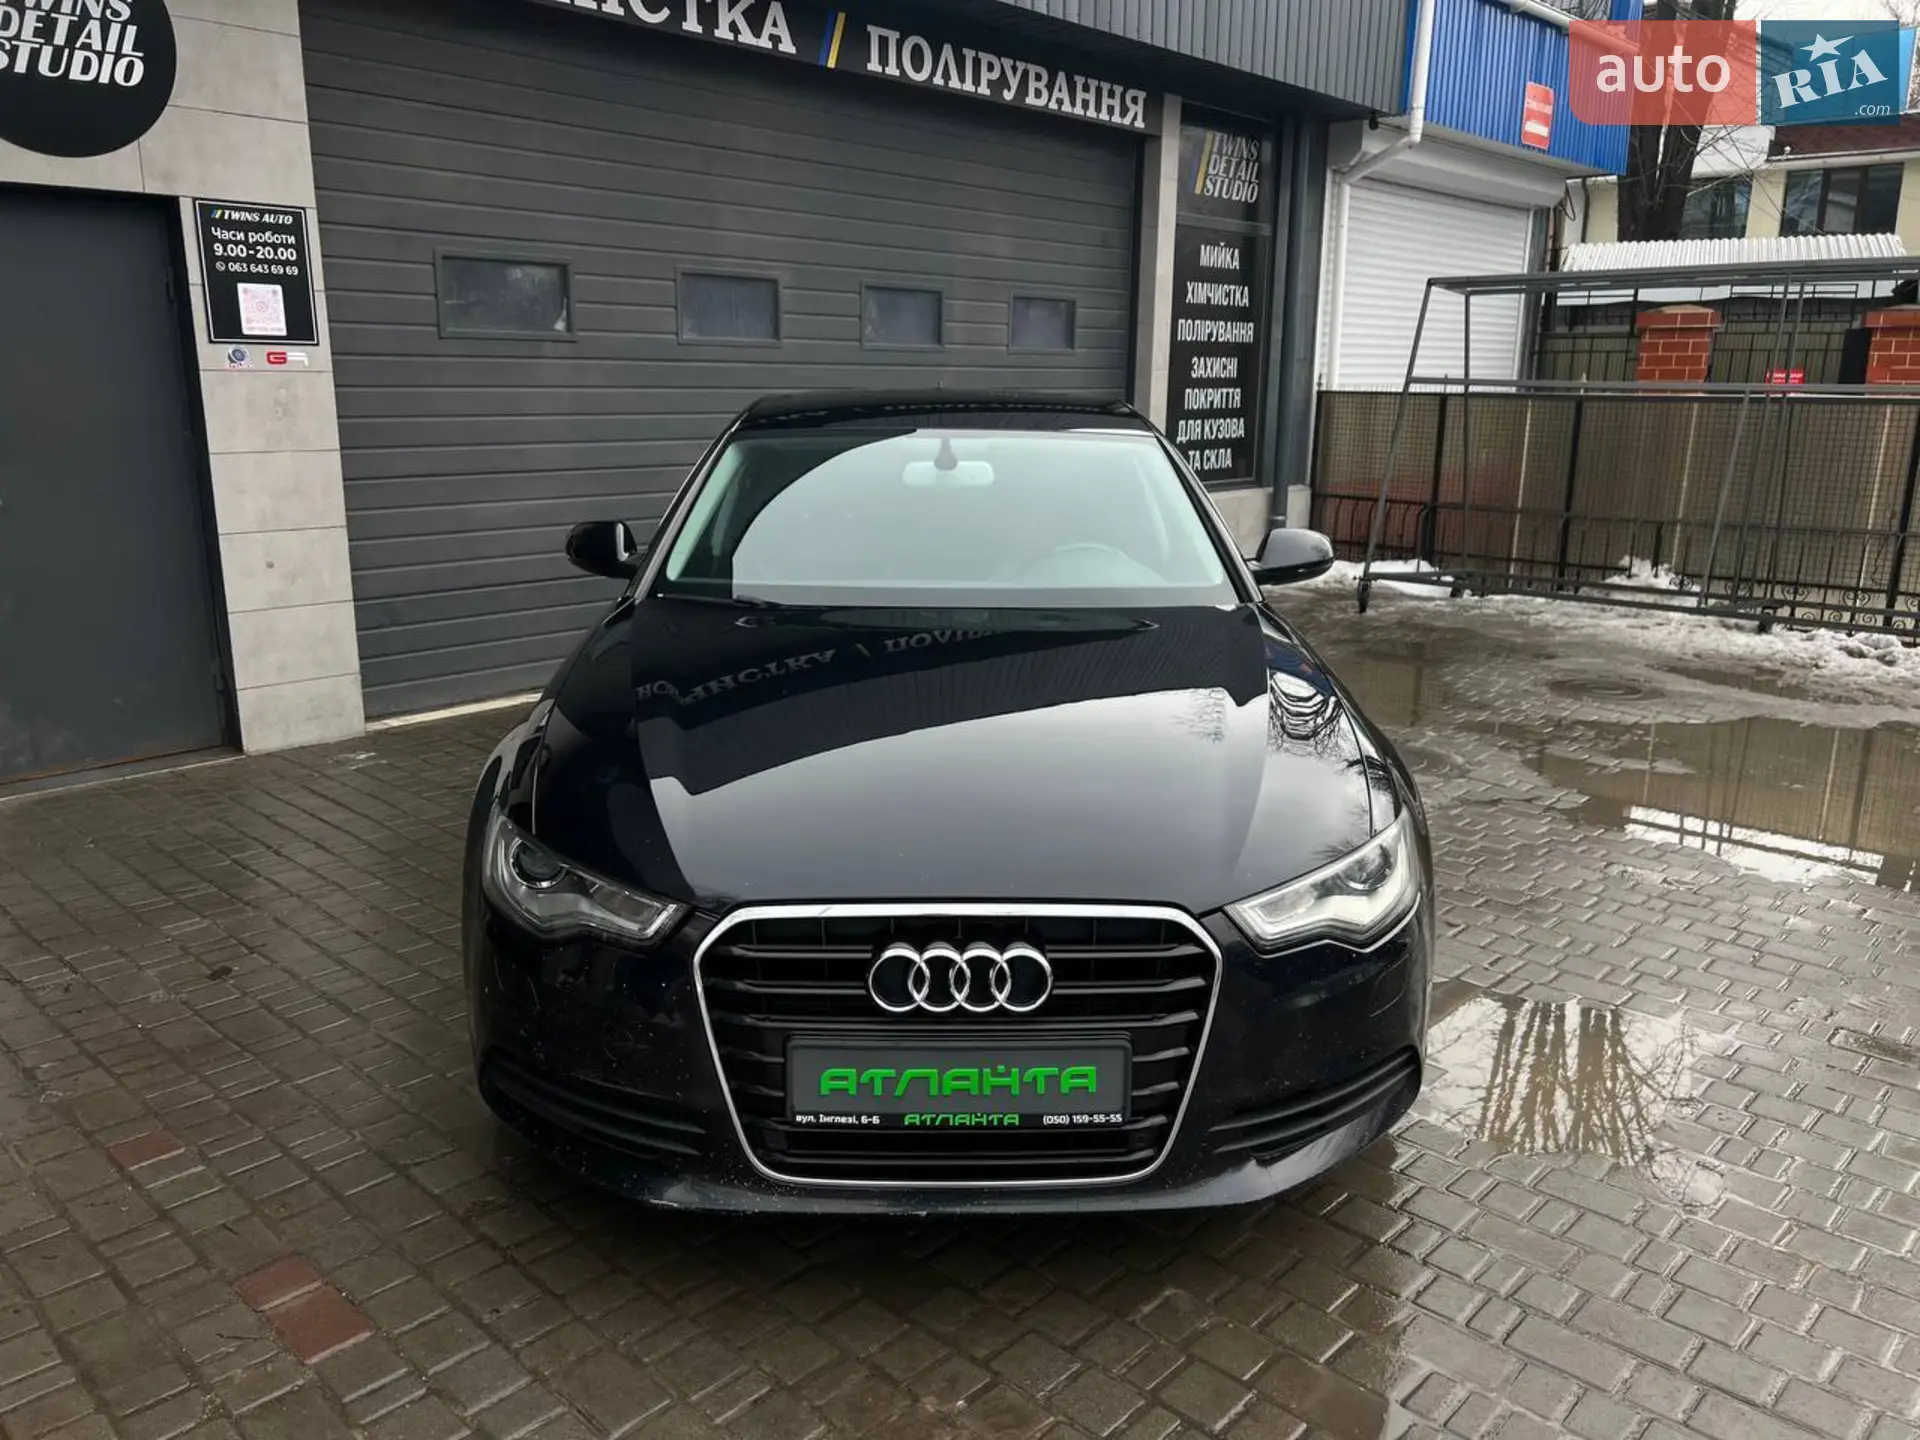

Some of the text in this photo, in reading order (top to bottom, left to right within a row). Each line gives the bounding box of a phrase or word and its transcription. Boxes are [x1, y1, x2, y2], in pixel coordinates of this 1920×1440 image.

[866, 24, 1147, 129] ПОЛІРУВАННЯ
[1213, 131, 1260, 160] TWINS
[1208, 154, 1259, 184] DETAIL
[1203, 174, 1259, 204] STUDIO
[223, 209, 293, 225] TWINS AUTO
[211, 226, 296, 245] Часи роботи
[228, 261, 299, 276] 063 643 69 69
[1199, 241, 1240, 270] МИЙКА
[1185, 281, 1249, 307] ХІМЧИСТКА
[1177, 318, 1255, 344] ПОЛІРУВАННЯ
[1191, 356, 1239, 379] ЗАХИСНІ
[1184, 388, 1242, 411] ПОКРИТТЯ
[1176, 417, 1245, 444] ДЛЯ КУЗОВА
[1188, 447, 1233, 471] ТА СКЛА
[1043, 1114, 1070, 1126] (050)
[1072, 1113, 1123, 1124] 159-55-55
